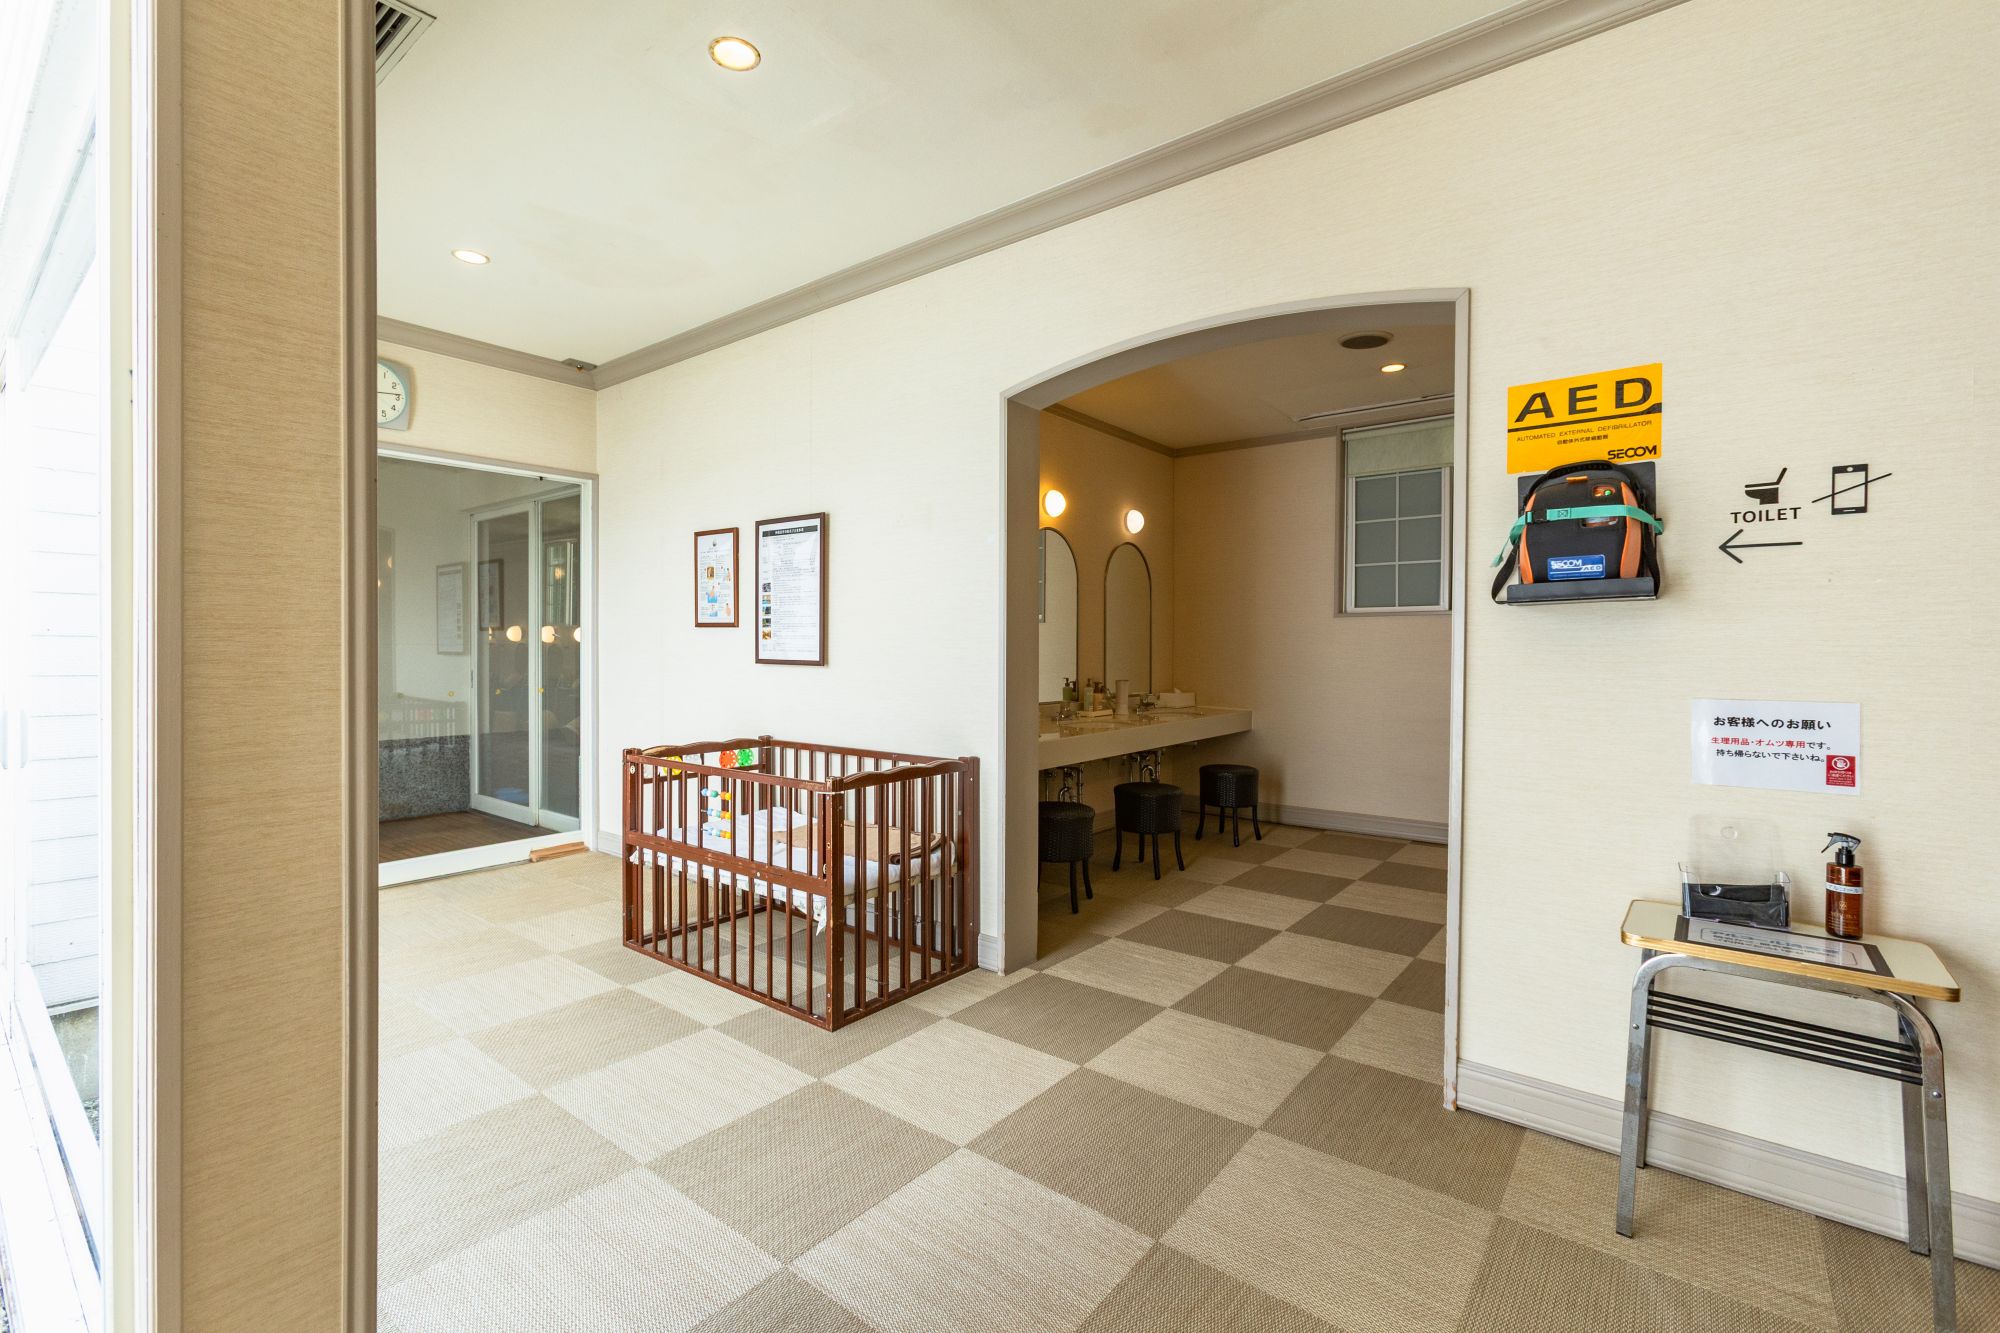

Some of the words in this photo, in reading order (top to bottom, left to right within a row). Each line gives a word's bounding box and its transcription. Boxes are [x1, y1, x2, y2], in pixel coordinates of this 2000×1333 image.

[391, 381, 397, 390] 2
[395, 393, 401, 401] 3
[1514, 377, 1653, 423] AED
[381, 409, 387, 418] 5
[1516, 432, 1556, 442] AUTOMATED
[1559, 428, 1594, 437] EXTERNAL
[1597, 420, 1653, 432] DEFIBRILLATOR
[1607, 445, 1658, 460] SECOM
[1730, 507, 1802, 523] TOILET
[1713, 716, 1832, 731] お客様へのお願い
[1716, 749, 1825, 762] 持ち帰らないで下さいね。
